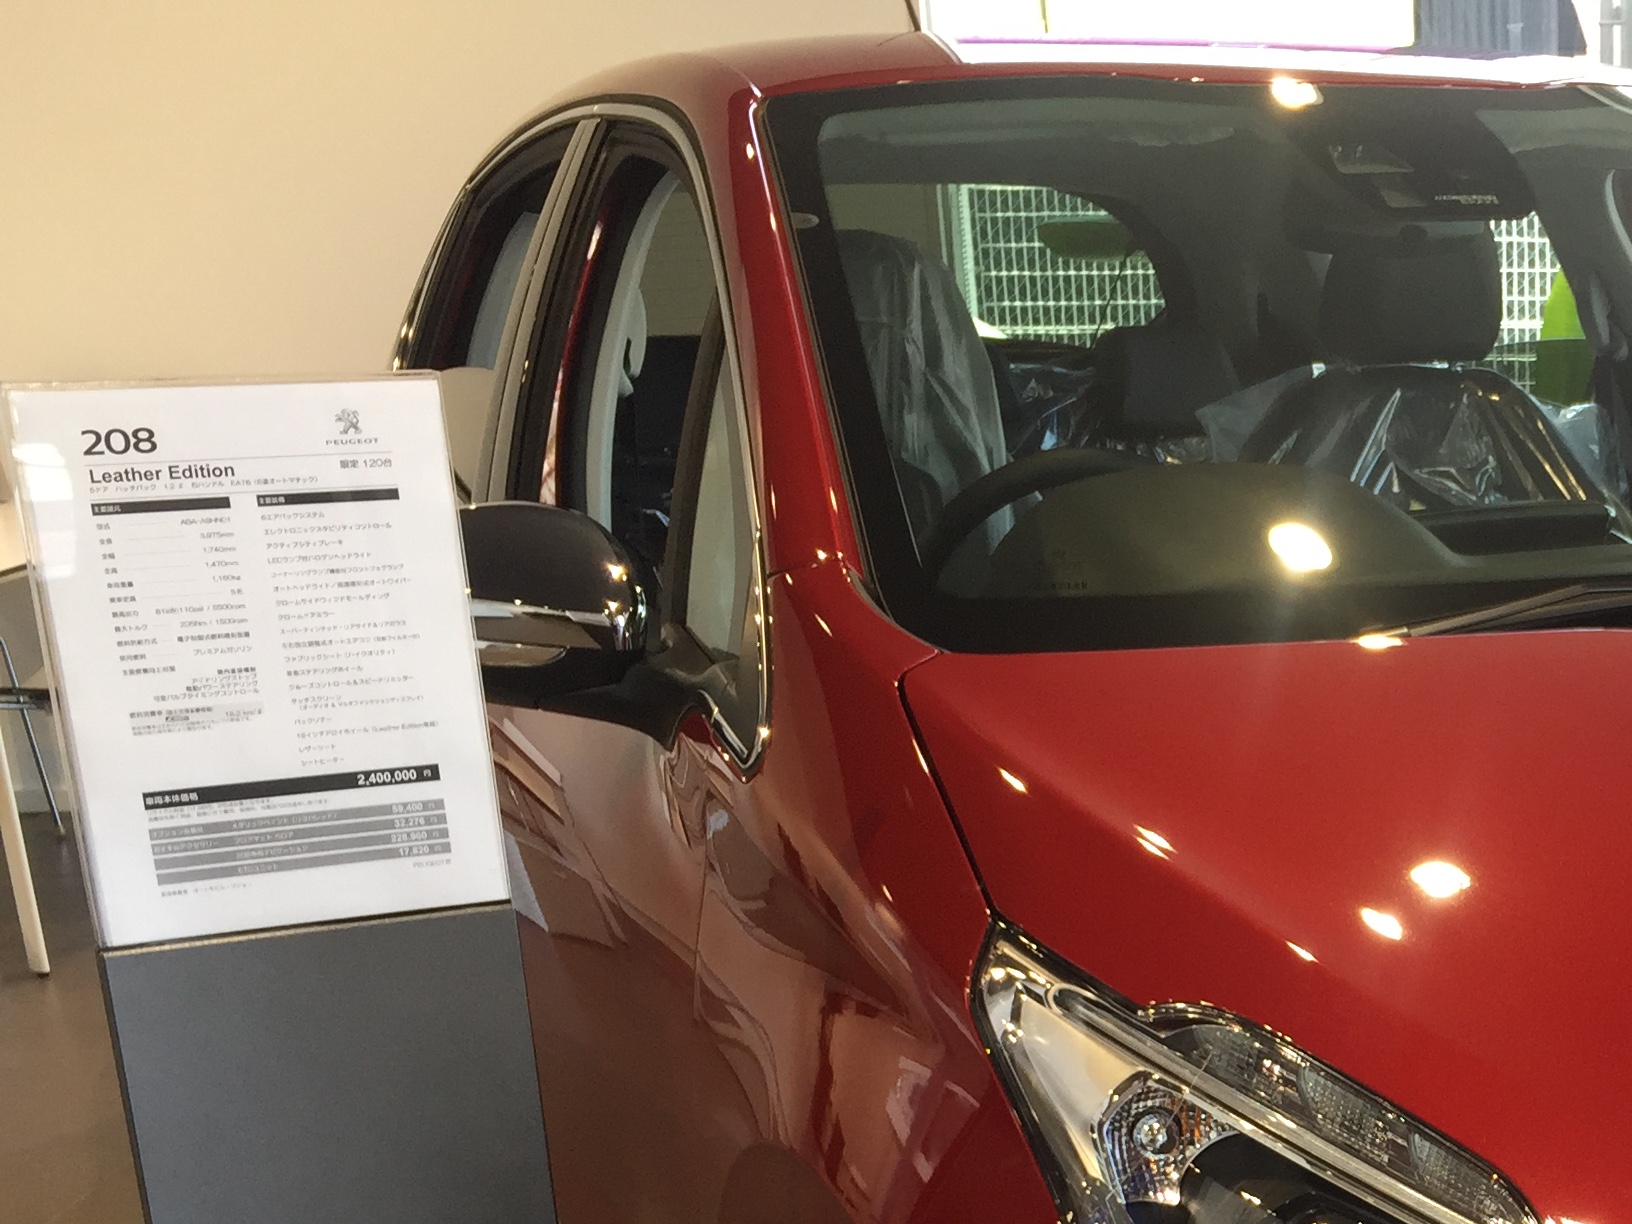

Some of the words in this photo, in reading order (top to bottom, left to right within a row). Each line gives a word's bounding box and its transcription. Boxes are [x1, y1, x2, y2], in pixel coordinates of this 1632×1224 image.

[81, 427, 158, 456] 208
[325, 437, 379, 446] PEUGEOT
[89, 466, 162, 484] Leather
[167, 463, 236, 480] Edition
[356, 768, 418, 787] 2,400,000
